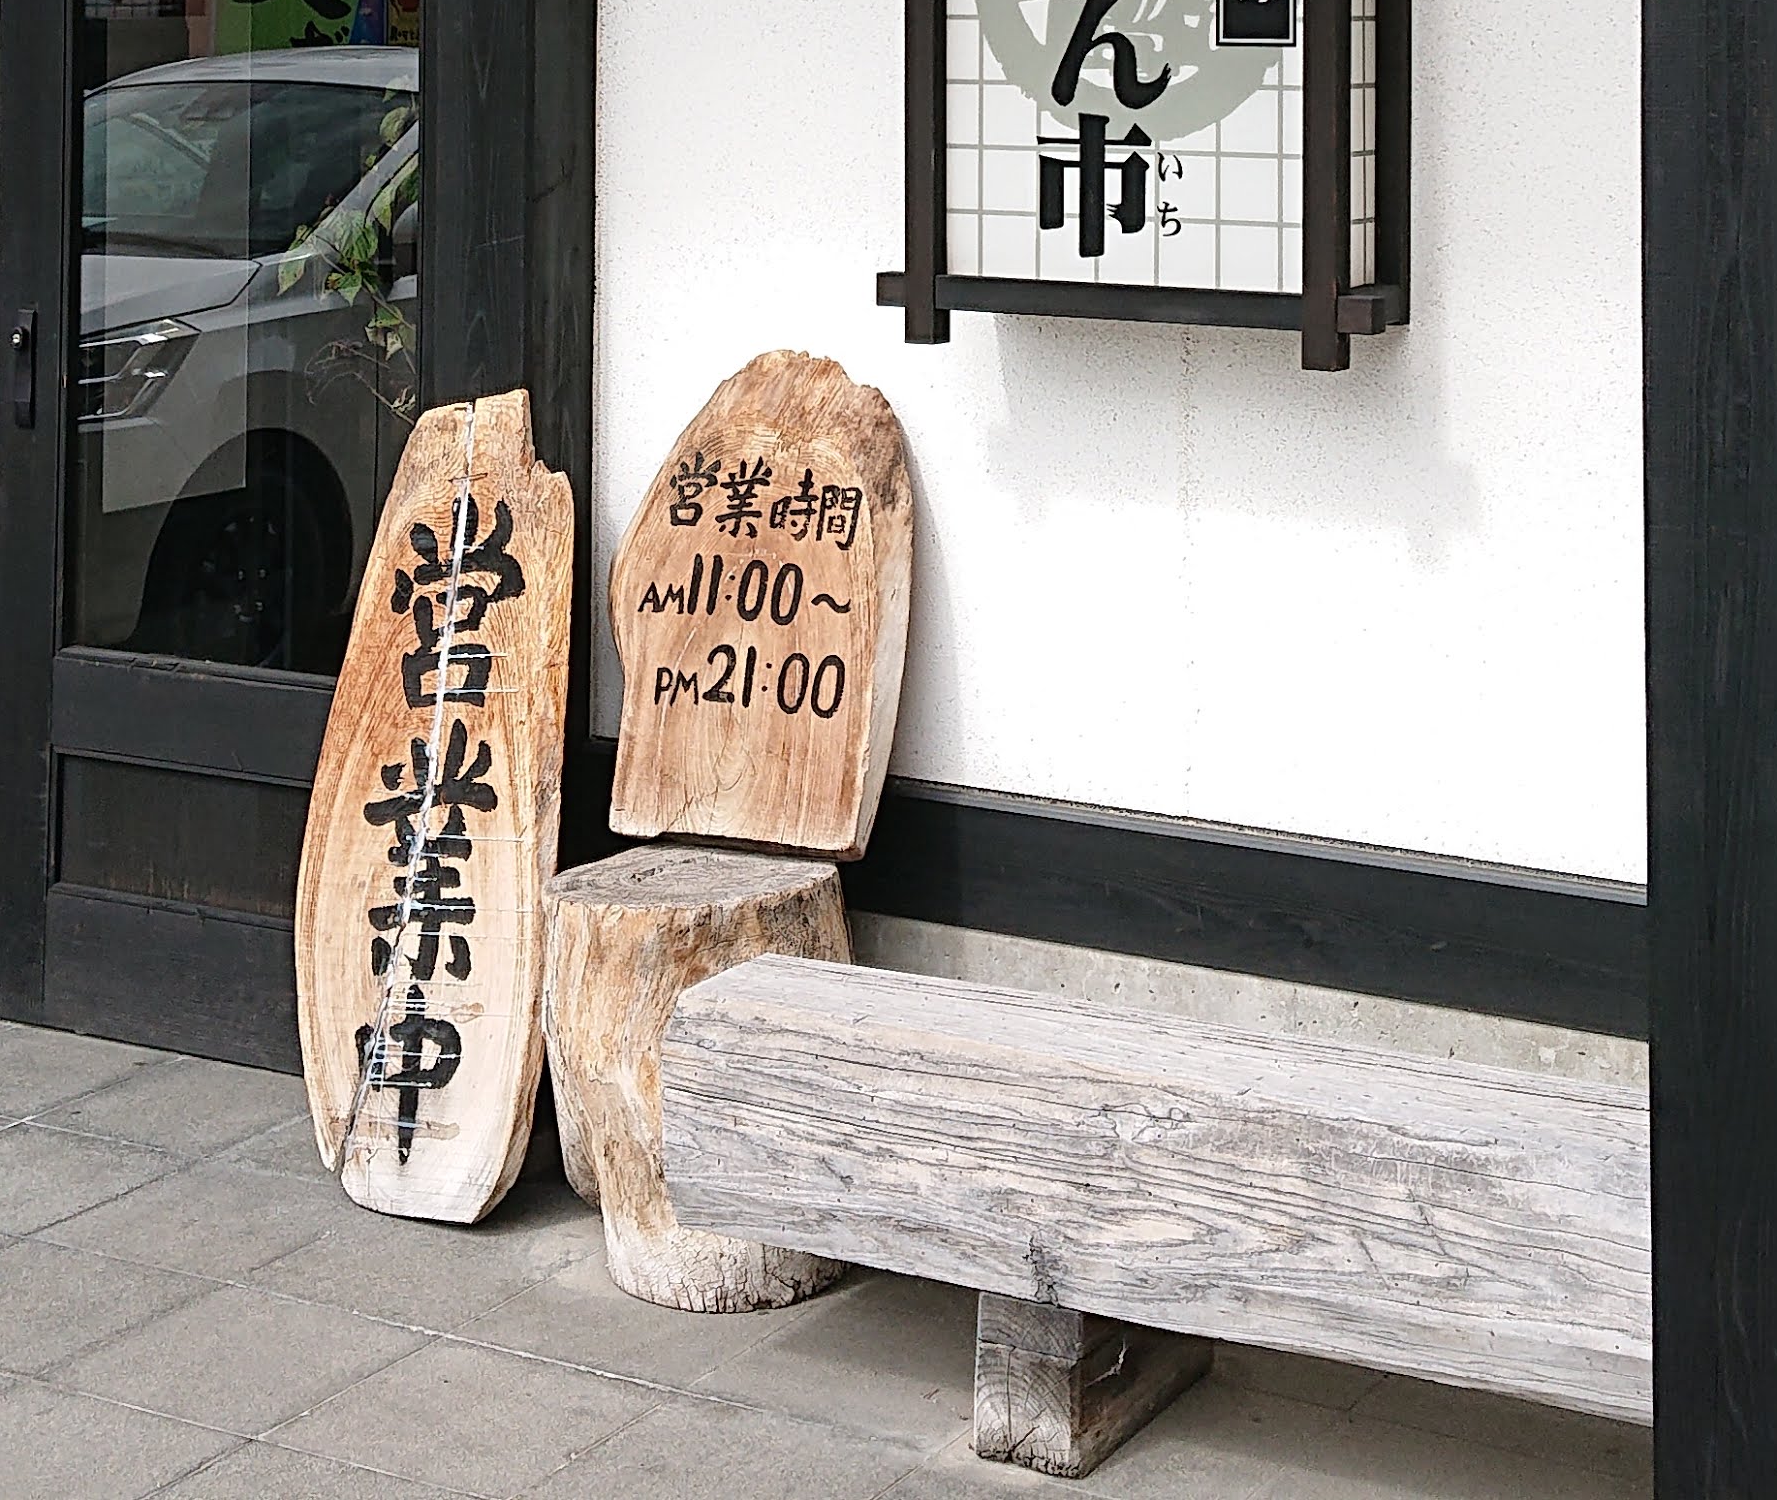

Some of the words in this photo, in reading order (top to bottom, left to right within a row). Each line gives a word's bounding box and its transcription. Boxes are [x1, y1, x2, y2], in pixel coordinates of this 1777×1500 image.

[1157, 149, 1185, 239] いち
[669, 452, 863, 551] 営業時間
[354, 496, 525, 1164] 営業中
